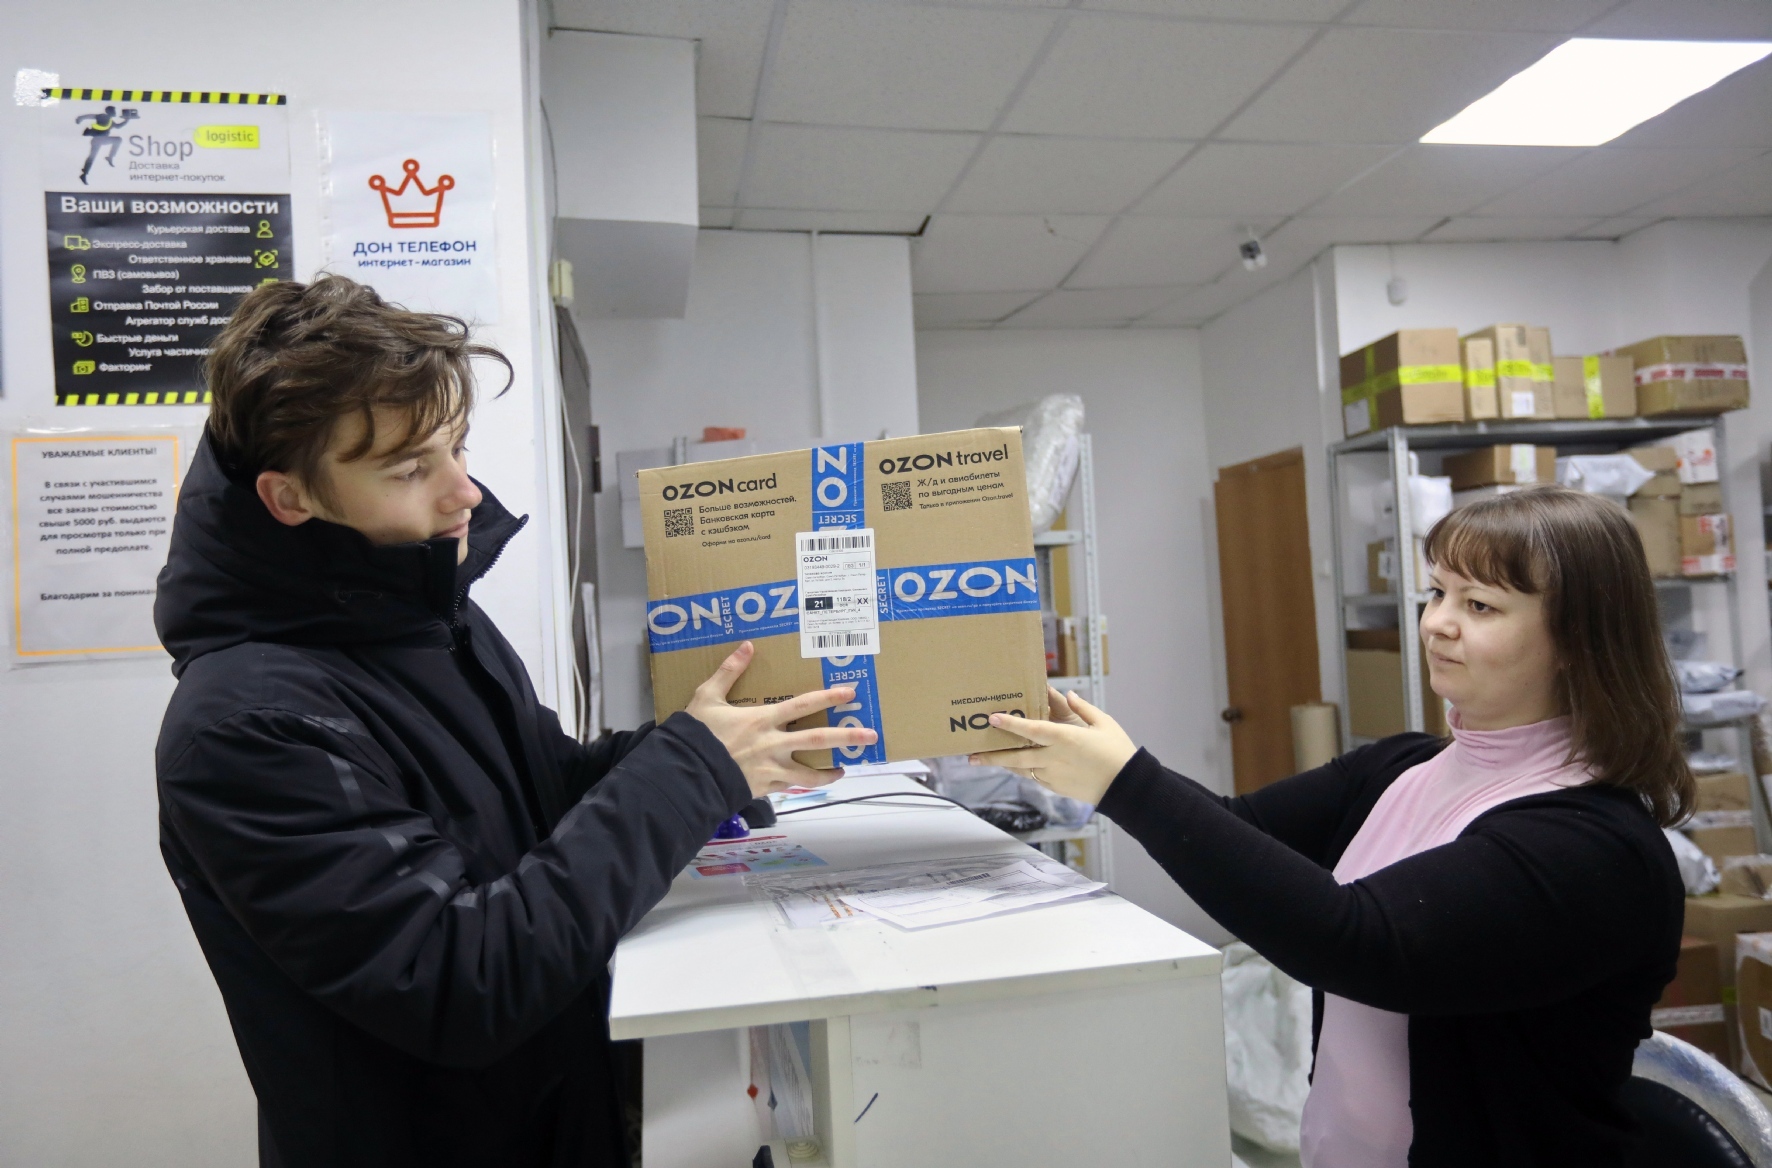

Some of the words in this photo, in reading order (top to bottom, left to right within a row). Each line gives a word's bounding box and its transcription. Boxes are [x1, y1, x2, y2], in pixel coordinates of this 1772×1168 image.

[128, 135, 193, 161] Shop
[206, 130, 254, 143] logistic
[128, 161, 180, 170] Доставка
[130, 173, 226, 183] интернет-покупок
[60, 196, 125, 214] Ваши
[131, 199, 279, 215] возможности
[147, 224, 204, 235] Курьерская
[205, 225, 250, 235] доставка
[92, 239, 187, 250] Экспресс-доставка
[353, 242, 393, 257] ДОН
[397, 240, 477, 254] ТЕЛЕФОН
[128, 254, 203, 264] Ответственное
[205, 255, 252, 265] хранение
[358, 257, 472, 269] интернет-магазин
[93, 270, 116, 280] ПВЗ
[117, 269, 180, 280] (самовывоз)
[142, 283, 174, 295] Забор
[175, 285, 187, 294] от
[188, 284, 253, 295] поставщиков
[93, 301, 143, 312] Отправка
[144, 300, 181, 310] Почтой
[183, 300, 219, 310] России
[125, 315, 176, 327] Агрегатор
[177, 314, 208, 327] служб
[96, 332, 143, 344] Быстрые
[144, 334, 179, 343] деньги
[128, 347, 162, 358] Услуга
[99, 363, 152, 373] Факторинг
[42, 448, 105, 459] УВАЖАЕМЫЕ
[879, 451, 953, 475] OZON
[956, 444, 1009, 466] travel
[90, 478, 158, 488] участившимся
[917, 477, 938, 487] Ж/д
[948, 472, 1000, 483] авиабилеты
[662, 478, 734, 501] OZON
[737, 473, 777, 493] card
[932, 486, 975, 497] выгодным
[977, 482, 1005, 491] ценам
[40, 494, 86, 504] случаями
[88, 490, 163, 500] мошенничества
[66, 506, 99, 514] заказы
[101, 504, 158, 512] стоимостью
[699, 504, 732, 514] Больше
[734, 496, 797, 510] возможностей.
[39, 520, 71, 528] свыше
[74, 517, 96, 526] 5000
[98, 516, 118, 526] руб.
[120, 515, 167, 525] выдаются
[700, 513, 749, 525] Банковская
[751, 510, 776, 519] карта
[818, 514, 857, 524] SECRET
[40, 533, 58, 542] для
[60, 531, 112, 540] просмотра
[114, 529, 147, 537] только
[149, 528, 167, 537] при
[708, 524, 750, 535] кэшбэком
[56, 545, 92, 555] полной
[94, 543, 152, 554] предоплате.
[803, 555, 828, 563] OZON
[894, 563, 1037, 602] OZON
[40, 591, 100, 601] Благодарим
[102, 590, 113, 598] за
[856, 597, 869, 605] XX
[877, 576, 889, 614] SECRET
[814, 600, 824, 608] 21
[720, 596, 734, 634] SECRET
[829, 668, 868, 682] SECRET
[951, 692, 1024, 706] онлайн-магазин
[950, 709, 1026, 732] OON
